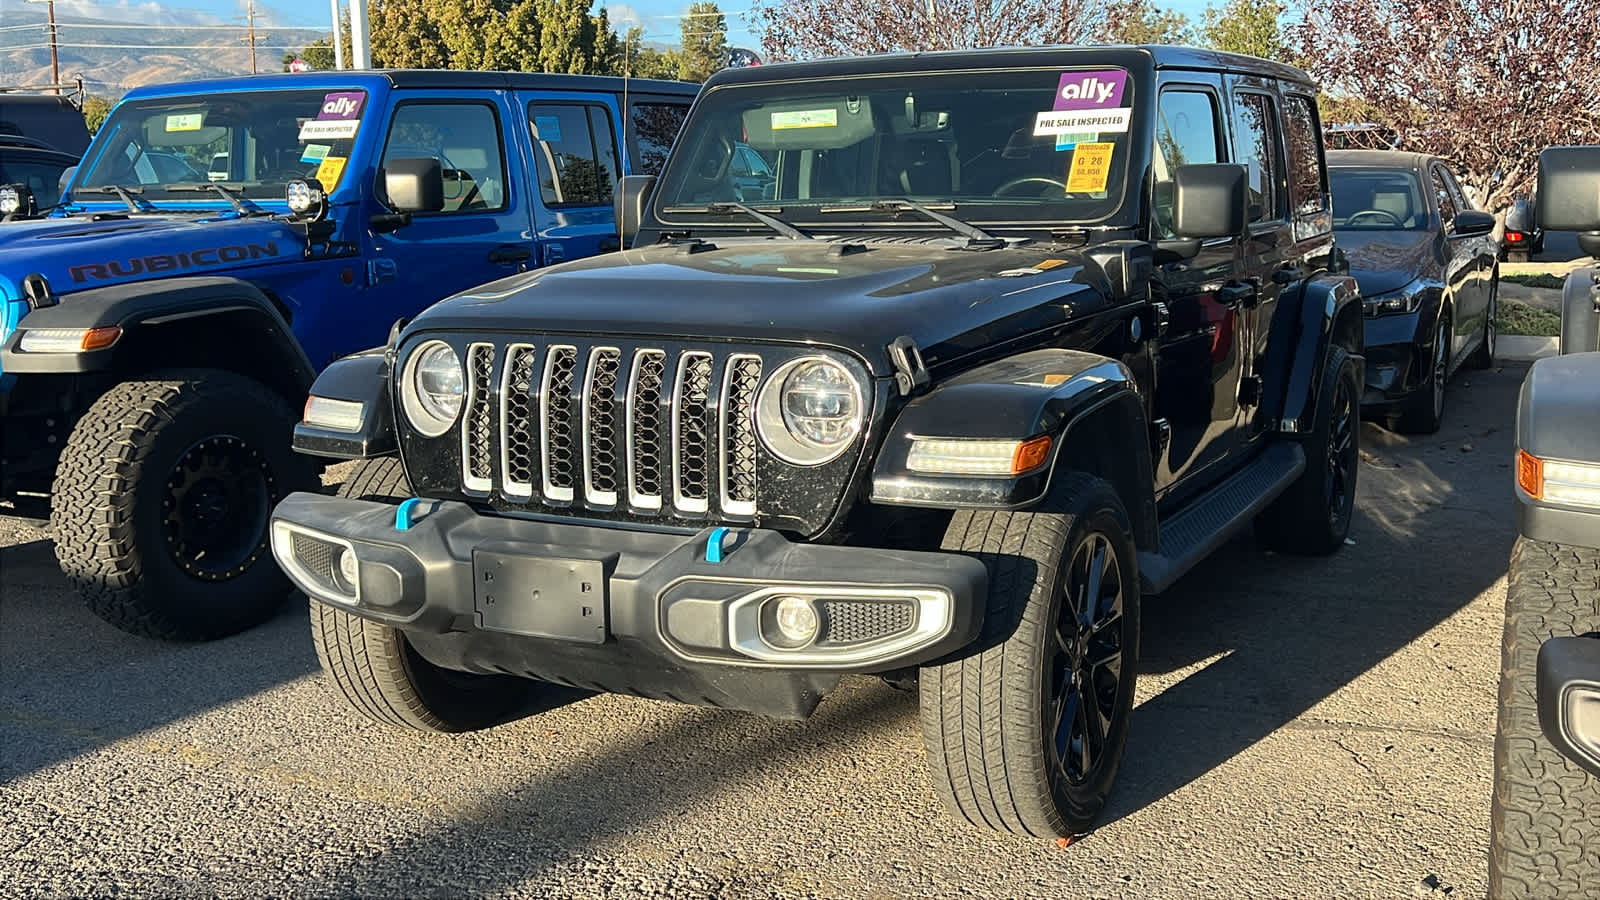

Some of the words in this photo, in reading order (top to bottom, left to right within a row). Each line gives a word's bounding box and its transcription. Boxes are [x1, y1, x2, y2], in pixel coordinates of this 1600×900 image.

[1039, 119, 1055, 128] PRE
[1056, 118, 1076, 128] SALE
[1077, 116, 1123, 126] INSPECTED
[69, 242, 280, 283] RUBICON
